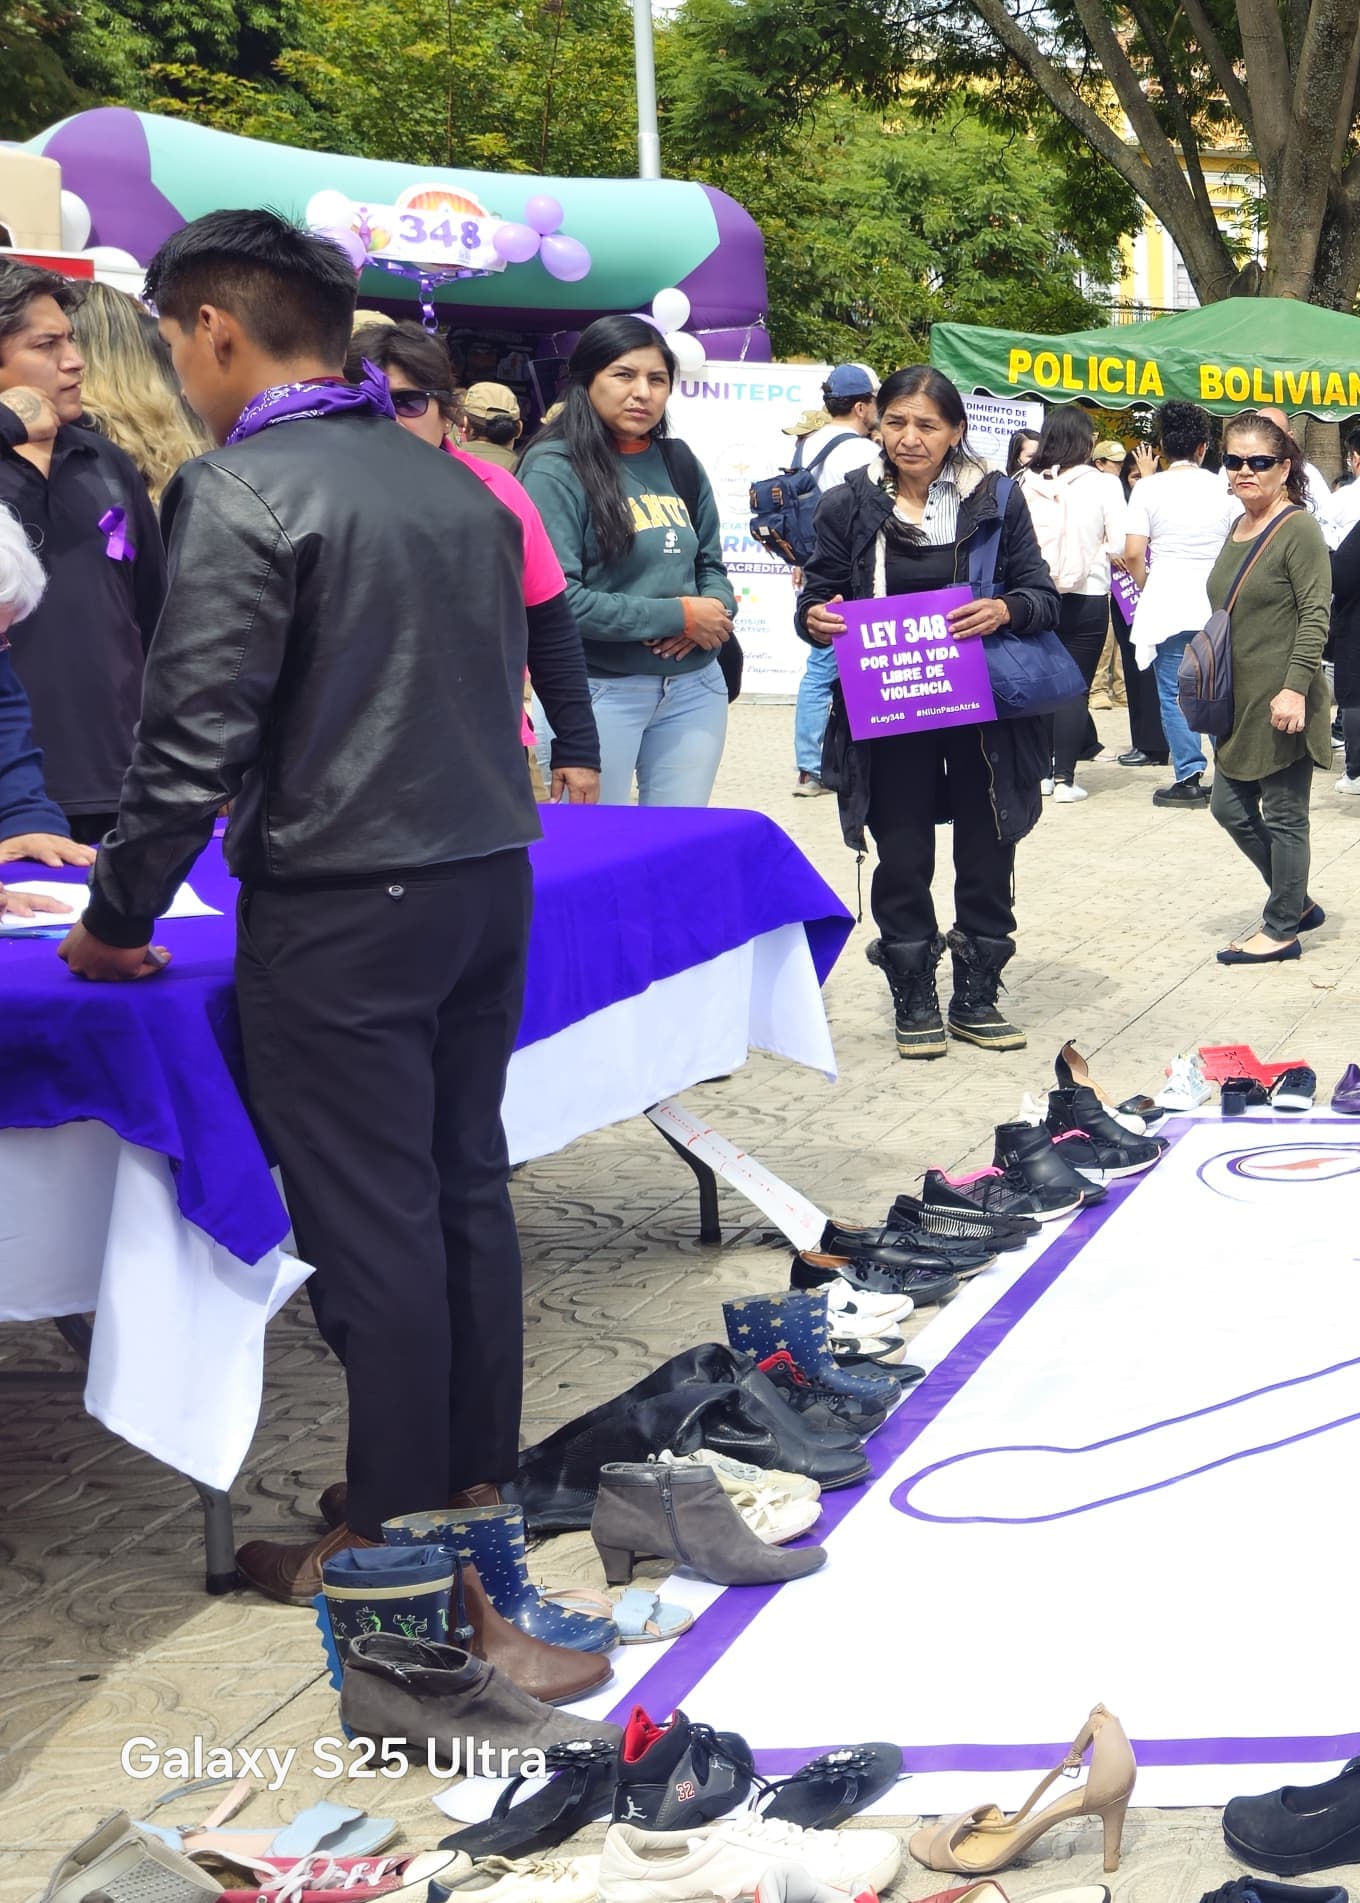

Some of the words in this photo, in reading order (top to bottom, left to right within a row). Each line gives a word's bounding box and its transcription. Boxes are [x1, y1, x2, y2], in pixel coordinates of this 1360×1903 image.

[400, 215, 481, 249] 348
[1008, 348, 1164, 397] POLICIA
[681, 380, 801, 402] UNITEPC
[966, 401, 1013, 416] DIMIENTO
[1015, 409, 1027, 417] DE
[969, 413, 1005, 424] NUNCIA
[1007, 418, 1027, 427] POR
[980, 425, 992, 433] DE
[860, 620, 896, 650] LEY
[902, 614, 948, 643] 348
[860, 655, 889, 671] POR
[893, 651, 923, 666] UNA
[926, 646, 960, 661] VIDA
[882, 668, 922, 685] LIBRE
[926, 664, 944, 678] DE
[880, 680, 952, 701] VIOLENCIA
[871, 712, 905, 724] #Ley348
